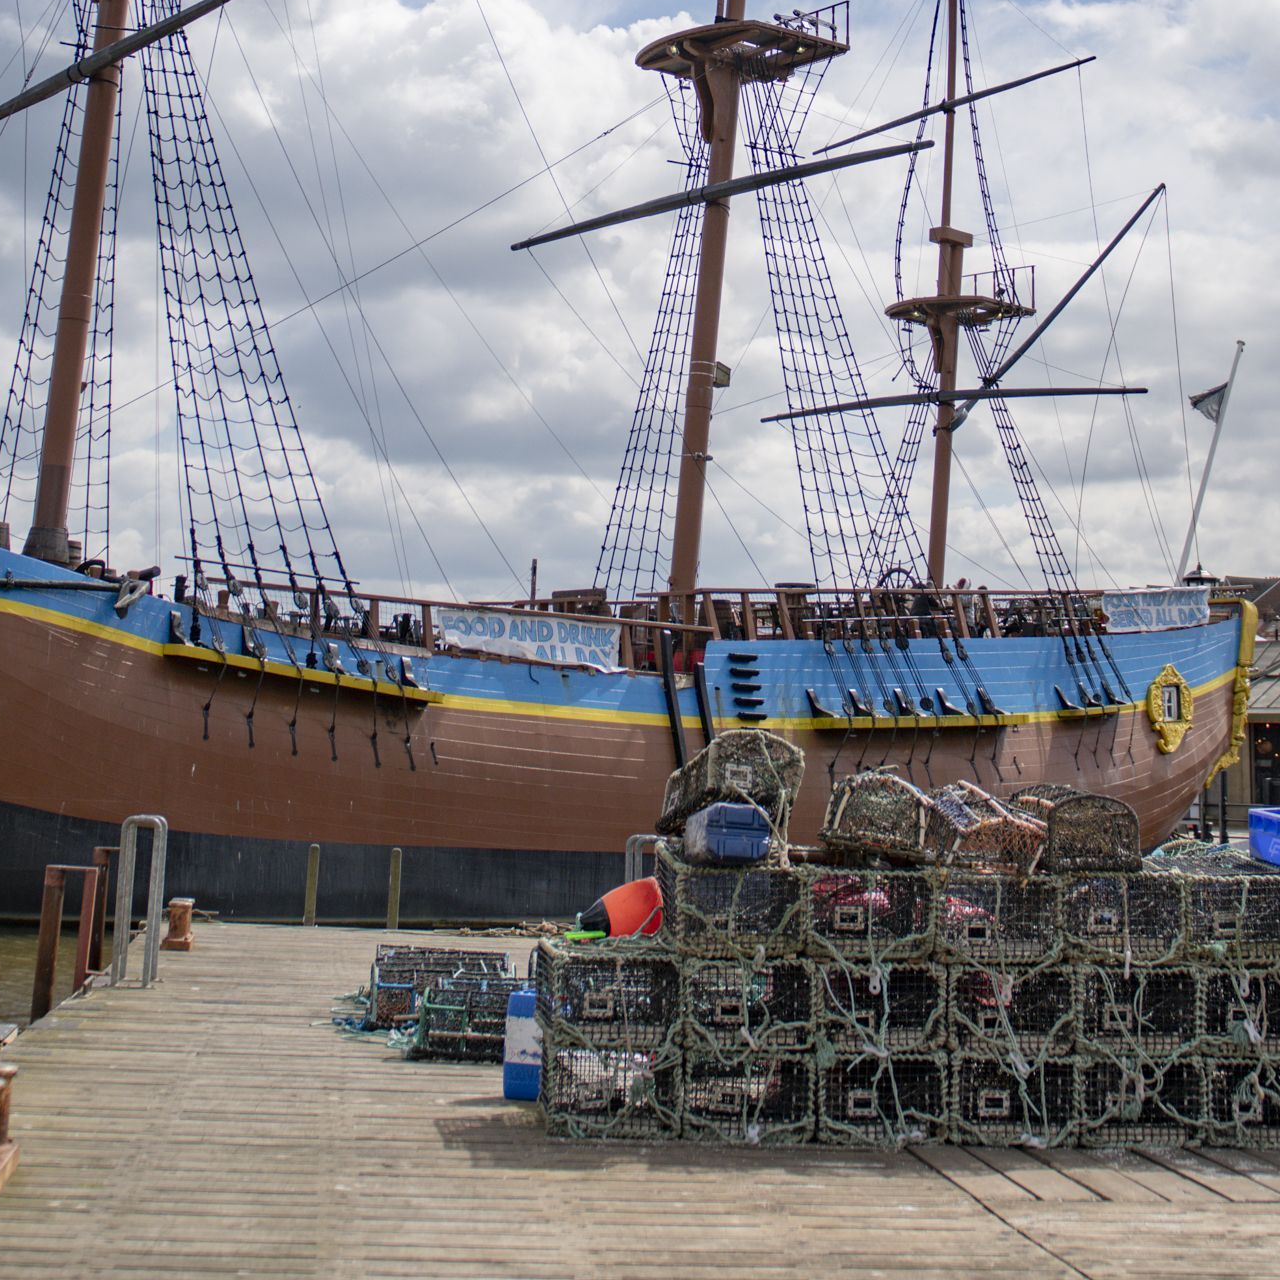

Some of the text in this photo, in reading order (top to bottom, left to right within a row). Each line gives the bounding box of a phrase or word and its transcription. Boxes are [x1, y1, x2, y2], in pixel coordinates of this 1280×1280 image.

[441, 615, 616, 649] FOOD AND DRINK
